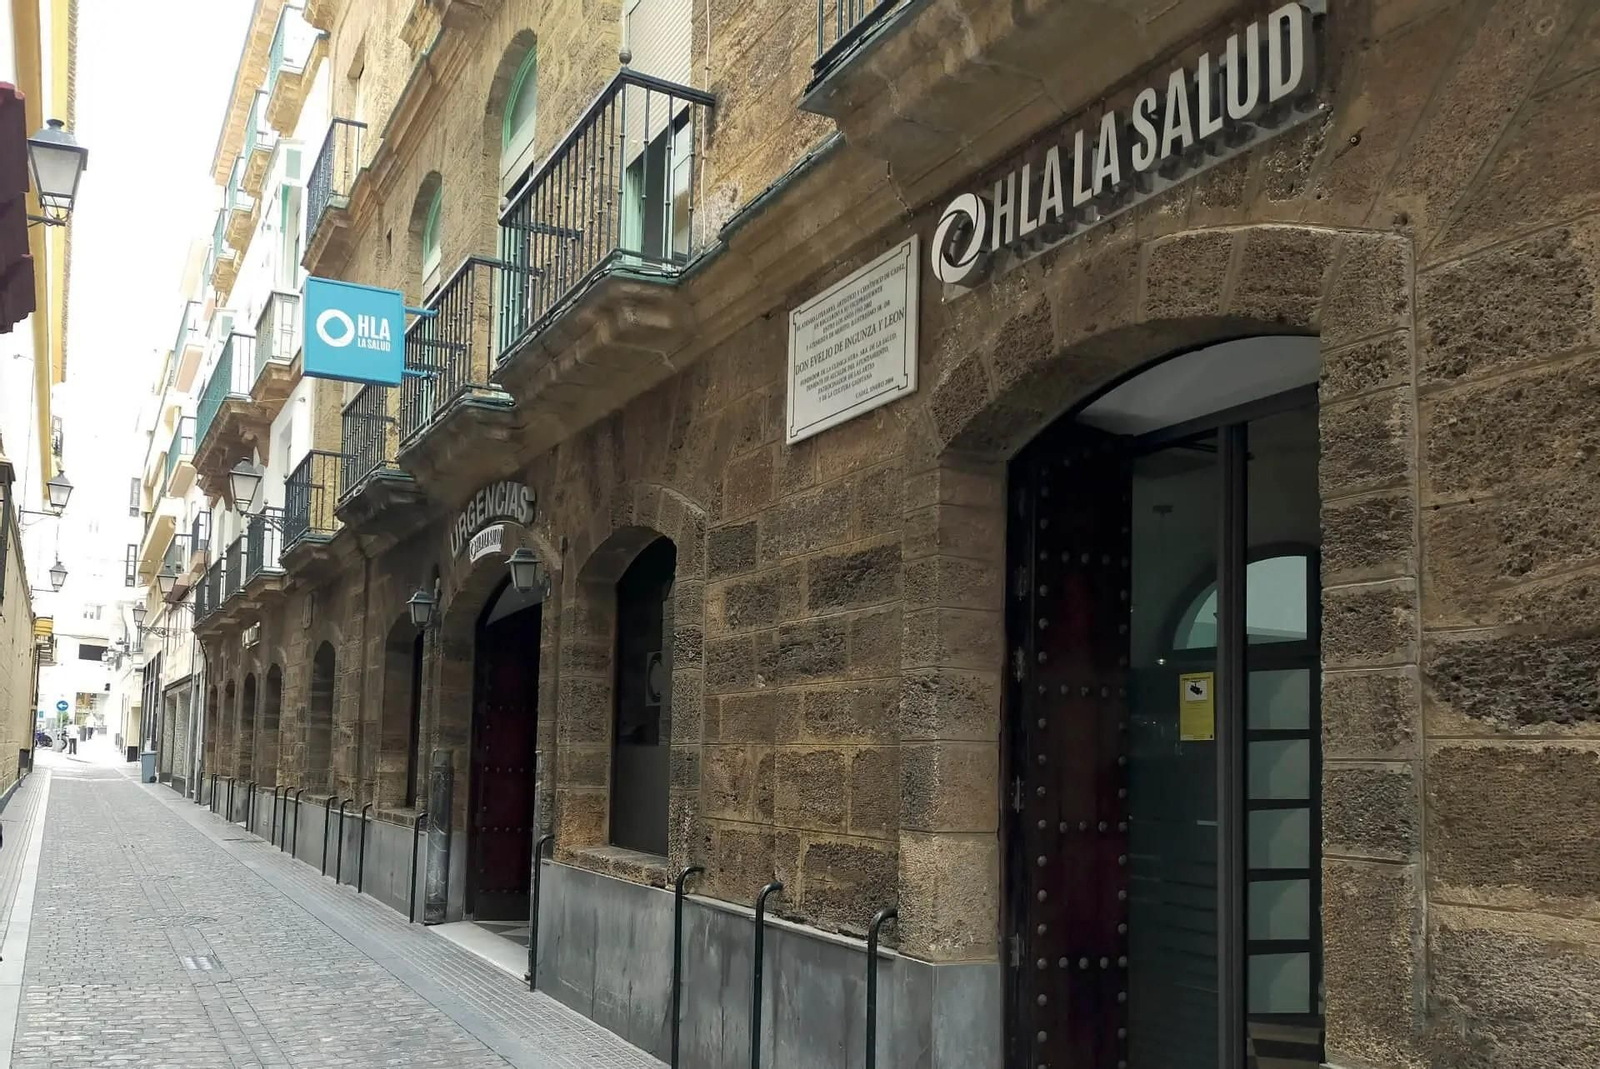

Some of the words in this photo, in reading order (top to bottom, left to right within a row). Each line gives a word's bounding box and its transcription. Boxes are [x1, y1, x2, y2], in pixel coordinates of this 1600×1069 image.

[992, 145, 1064, 252] HLA
[1073, 111, 1120, 207] LA
[1132, 2, 1304, 172] SALUD
[358, 314, 391, 341] HLA
[358, 338, 367, 348] LA
[367, 340, 391, 352] SALUD
[795, 358, 808, 375] DON
[810, 345, 833, 367] EVELIO
[834, 340, 842, 355] DE
[844, 322, 876, 350] INGUNZA
[878, 318, 882, 332] Y
[450, 481, 529, 559] URGENCIAS
